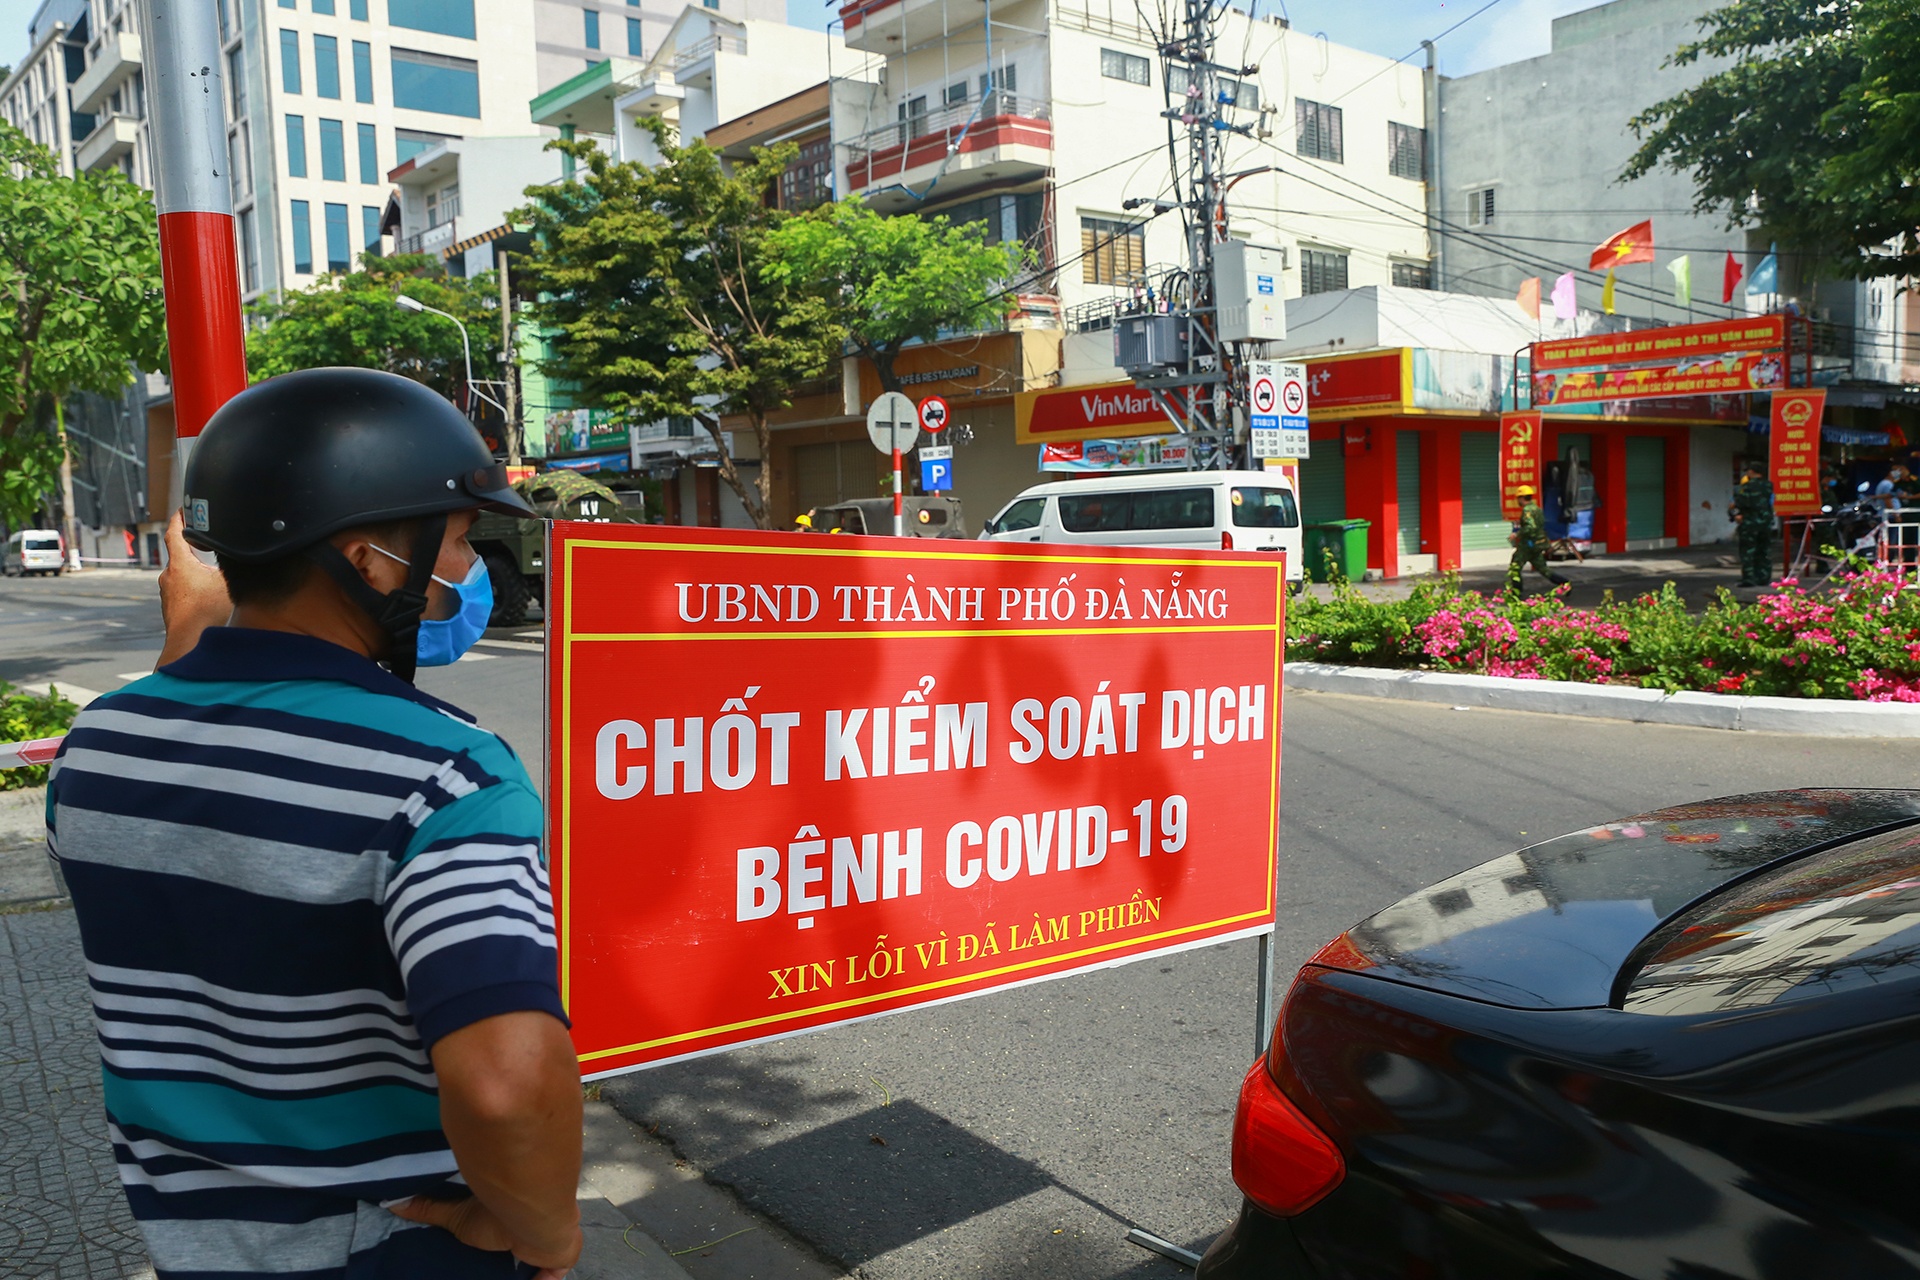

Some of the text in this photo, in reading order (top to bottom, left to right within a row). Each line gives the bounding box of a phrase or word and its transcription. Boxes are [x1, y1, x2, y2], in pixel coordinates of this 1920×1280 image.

[1701, 334, 1719, 345] THỊ
[1744, 327, 1773, 339] MINH
[897, 374, 915, 385] AFÉ
[922, 366, 978, 383] RESTAURANT
[1256, 364, 1272, 376] ZONE
[1284, 366, 1299, 378] ZONE
[932, 465, 945, 483] P
[580, 501, 599, 515] KV
[675, 571, 1228, 623] UBND THÀNH PHỐ ĐÀ NẴNG
[595, 675, 1266, 800] CHỐT KIỂM SOÁT DỊCH
[736, 794, 1188, 930] BỆNH COVID-19
[769, 889, 1163, 1000] XIN LỖI VÌ ĐÃ LÀM PHIỀN
